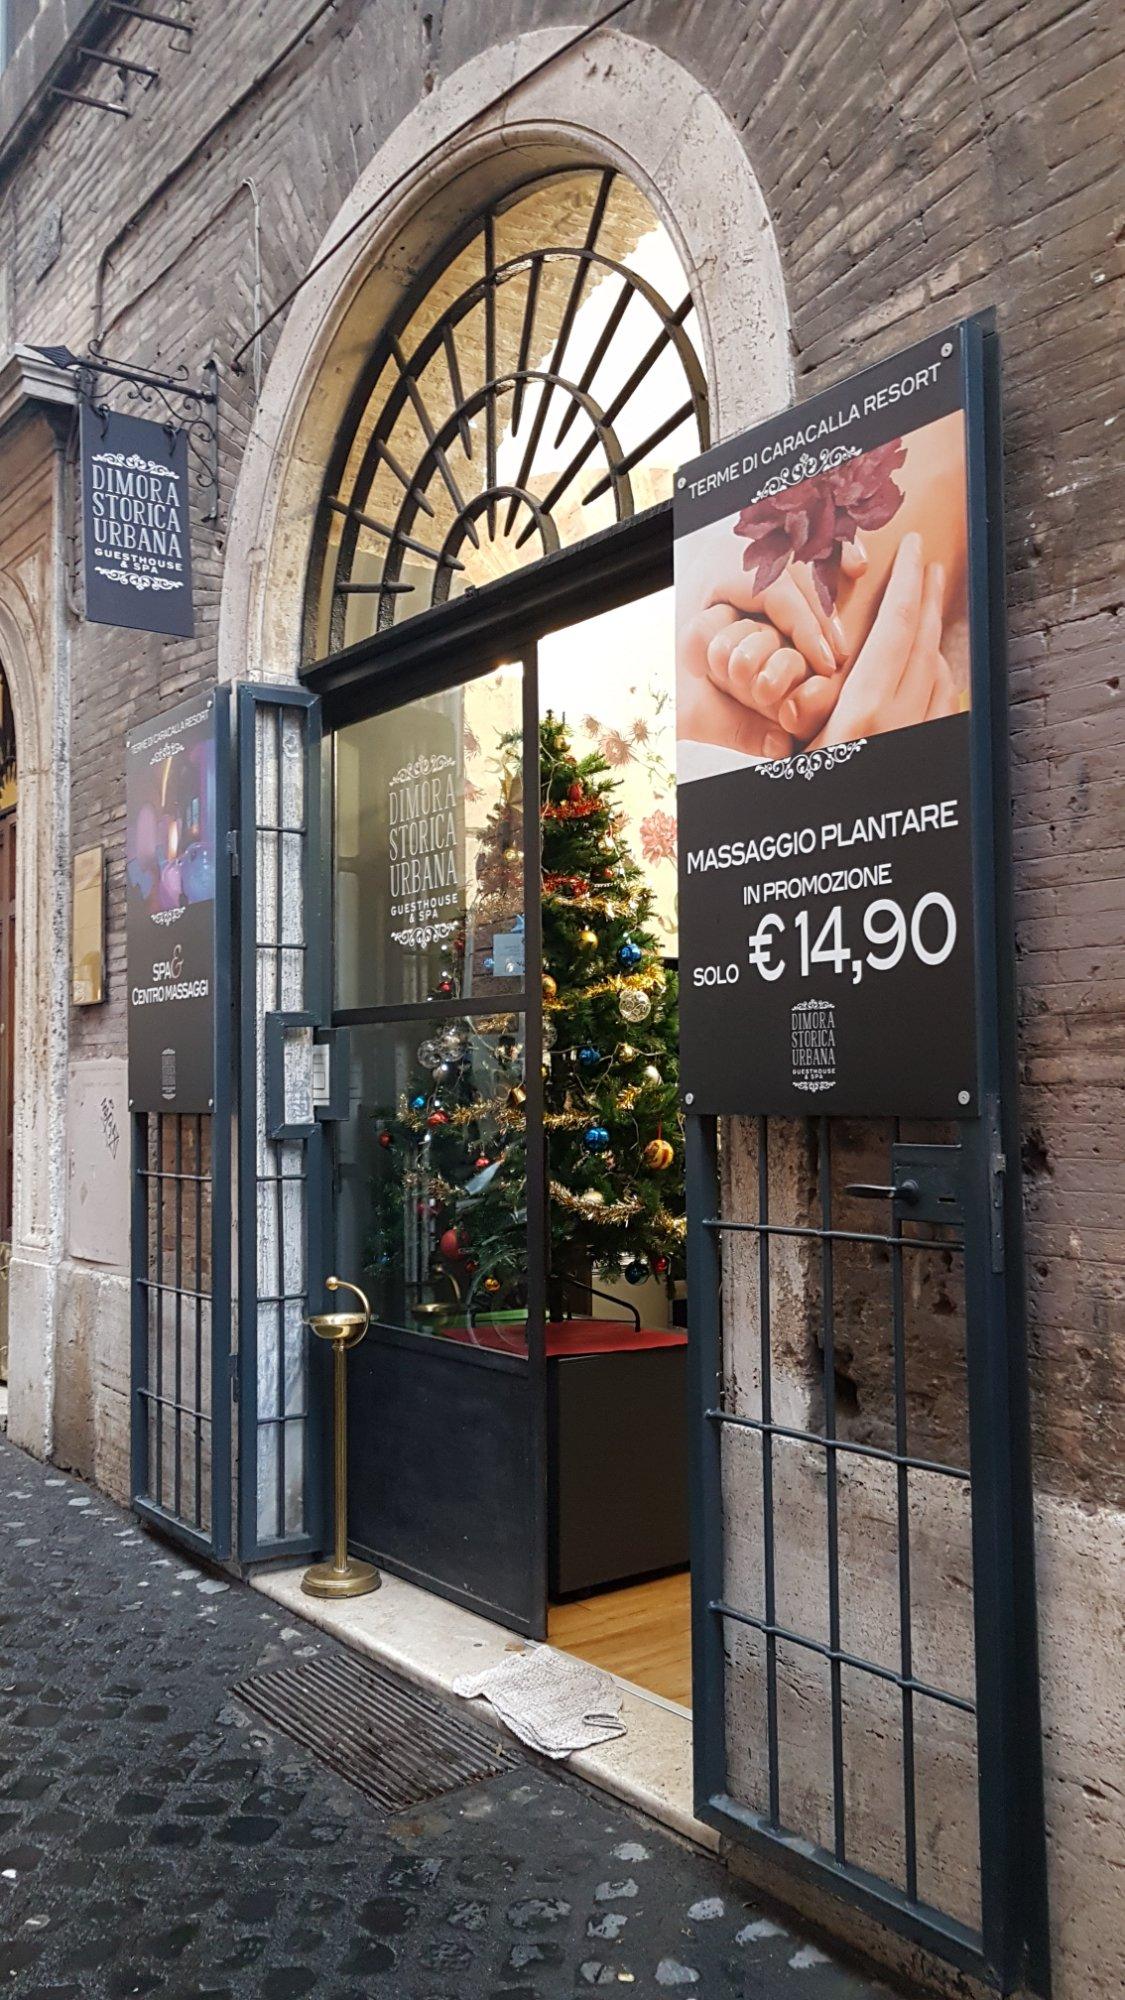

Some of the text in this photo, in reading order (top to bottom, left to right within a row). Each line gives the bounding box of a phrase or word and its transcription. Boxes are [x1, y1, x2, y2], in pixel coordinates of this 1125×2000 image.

[688, 362, 941, 499] TERME DI CARACALLA RESORT
[92, 464, 181, 507] DIMORA
[92, 492, 182, 533] STORICA
[93, 517, 182, 559] URBANA
[94, 548, 183, 571] GUESTHOUSE
[120, 560, 159, 574] & SPA
[389, 773, 457, 826] DIMORA
[389, 811, 458, 861] STORICA
[687, 800, 959, 874] MASSAGGIO PLANTARE
[390, 850, 458, 898] URBANA
[743, 863, 893, 906] IN PROMOZIONE
[391, 893, 458, 917] GUESTHOUSE
[409, 909, 439, 923] & SPA
[152, 962, 172, 982] SPA
[693, 963, 739, 987] SOLO
[132, 979, 209, 1006] CENTRO MASSAGGI
[791, 1011, 836, 1031] DIMORA
[791, 1029, 836, 1048] STORICA
[792, 1048, 836, 1066] URBANA
